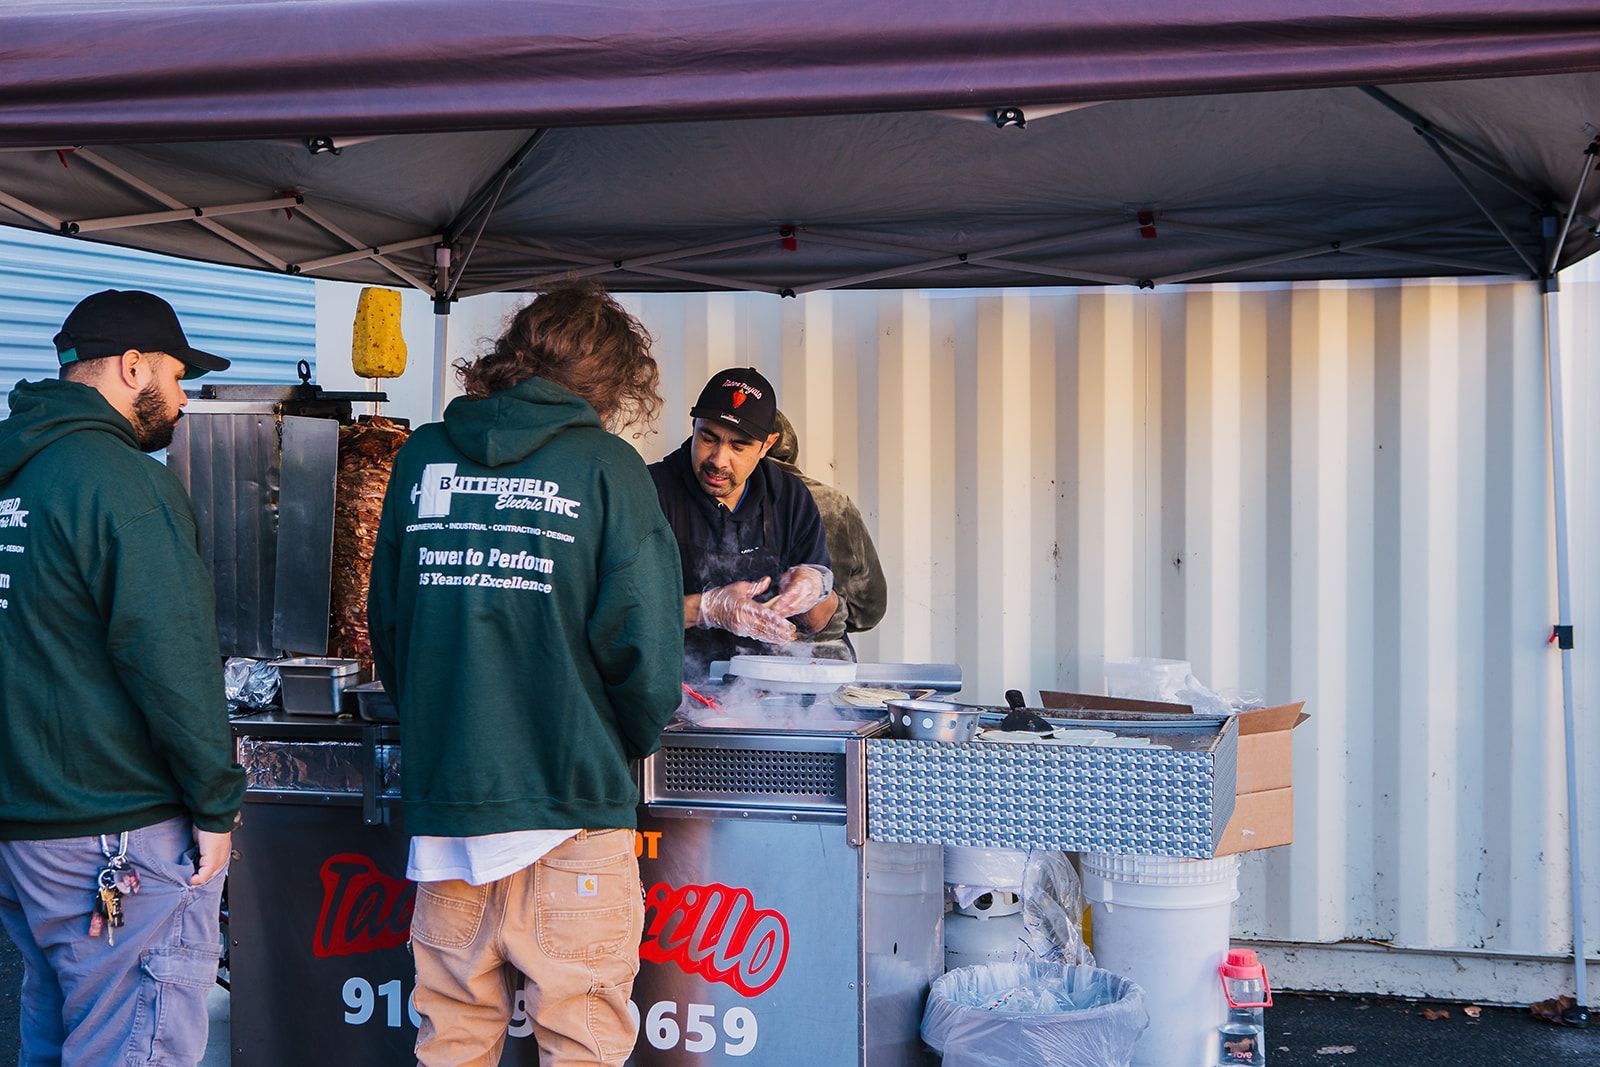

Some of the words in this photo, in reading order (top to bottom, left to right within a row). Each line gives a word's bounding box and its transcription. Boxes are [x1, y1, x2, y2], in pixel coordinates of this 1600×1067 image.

[440, 476, 559, 496] BUTTERFIELD
[495, 494, 543, 511] Electric
[406, 523, 445, 532] COMMERCIAL
[449, 523, 488, 531] INDUSTRIAL
[492, 523, 541, 535] CONTRACTING
[546, 530, 575, 543] DESIGN
[419, 547, 464, 566] Power
[465, 548, 484, 566] to
[487, 548, 554, 574] Perform
[463, 573, 480, 586] of
[478, 574, 553, 593] Excellence
[342, 977, 421, 1028] 91
